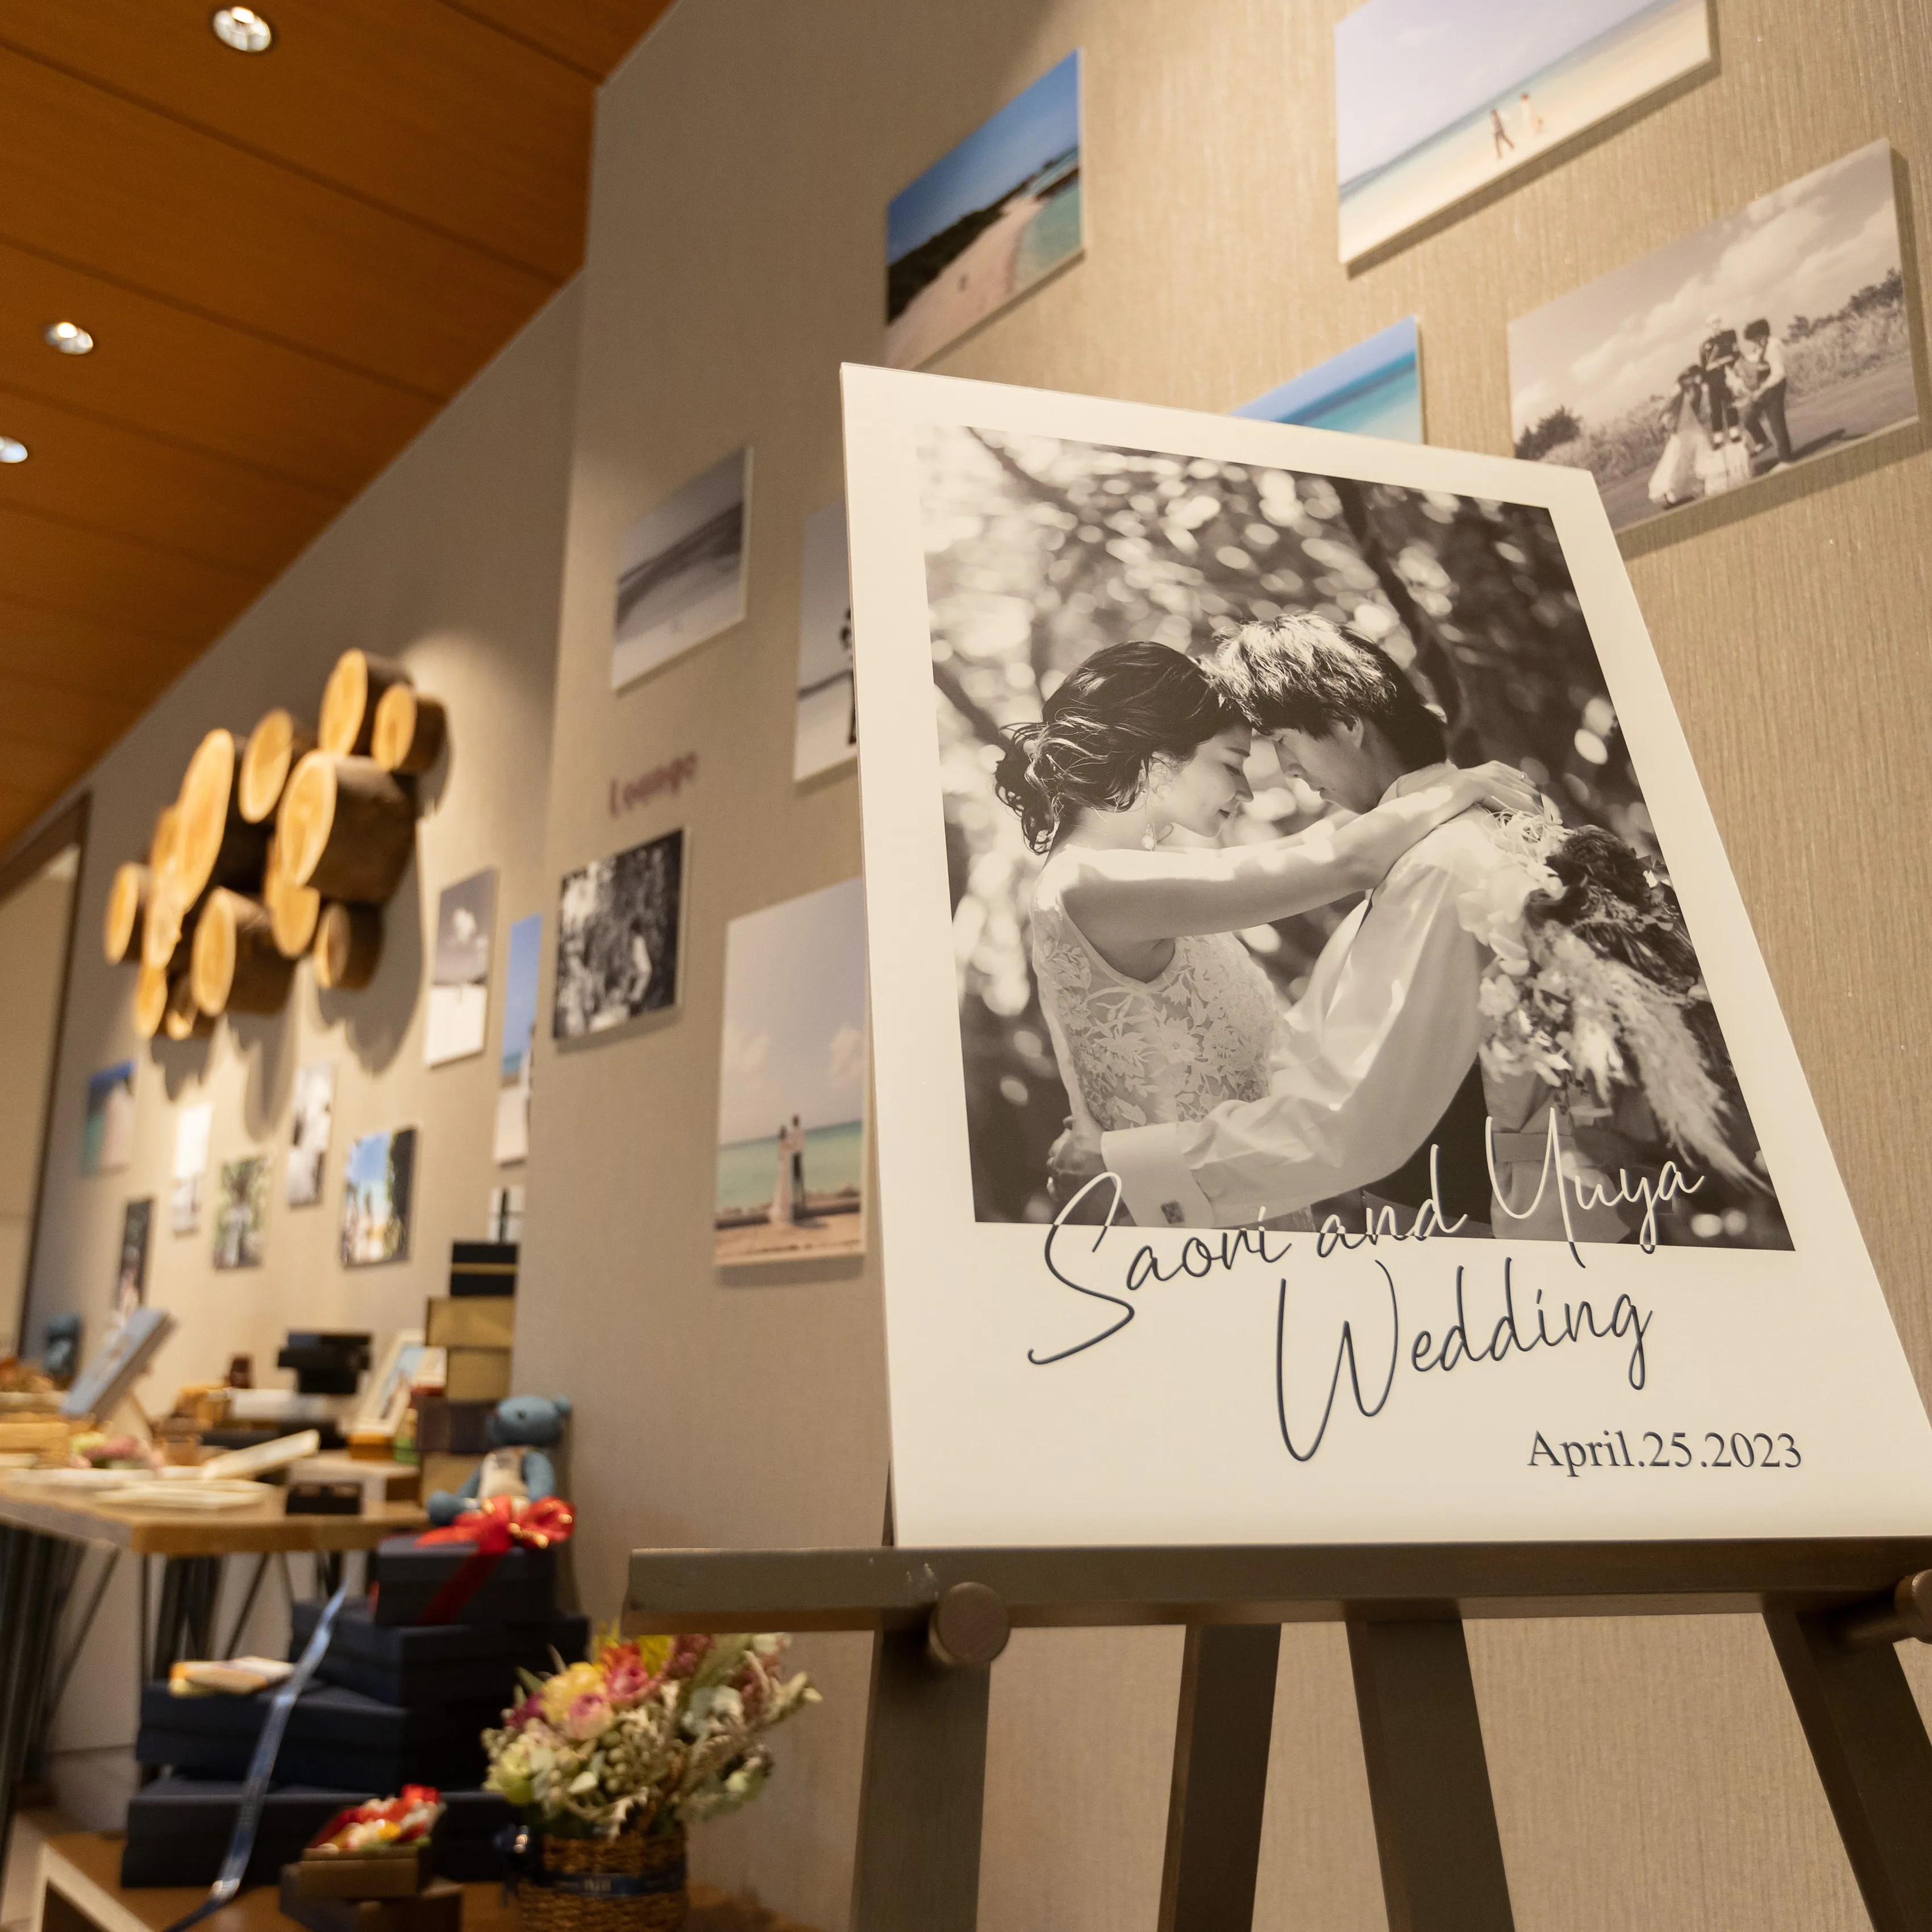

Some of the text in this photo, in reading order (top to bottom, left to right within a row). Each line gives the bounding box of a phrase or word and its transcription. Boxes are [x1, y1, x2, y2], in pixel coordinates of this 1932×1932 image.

[1028, 1107, 1705, 1364] Saori and Yuya
[1276, 1257, 1654, 1462] Wedding
[1528, 1430, 1802, 1477] April.25.2023
